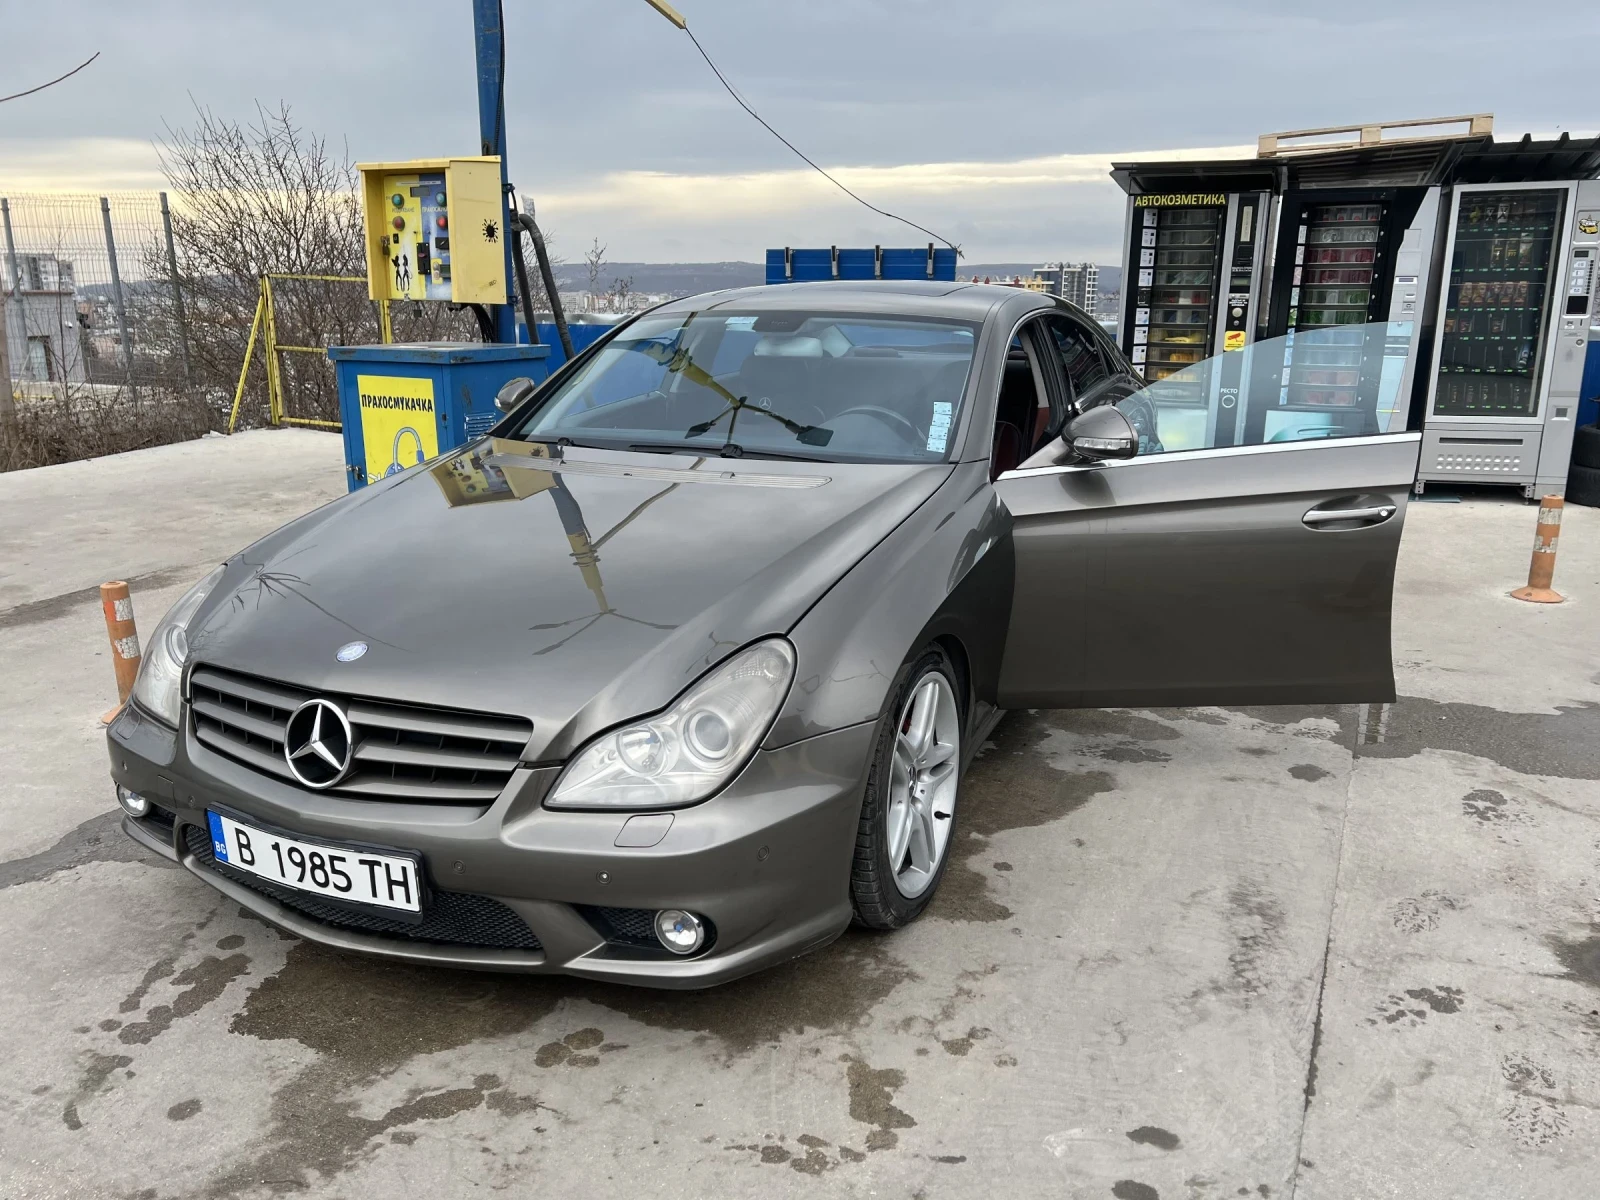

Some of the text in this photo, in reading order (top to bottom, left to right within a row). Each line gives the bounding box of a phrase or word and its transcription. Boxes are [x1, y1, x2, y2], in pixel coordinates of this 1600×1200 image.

[1135, 193, 1226, 207] АВТОКОЗМЕТИКА
[361, 394, 434, 413] ПРАХОСМУКАЧКА
[215, 841, 227, 855] BG
[235, 828, 412, 904] B 1985 TH
